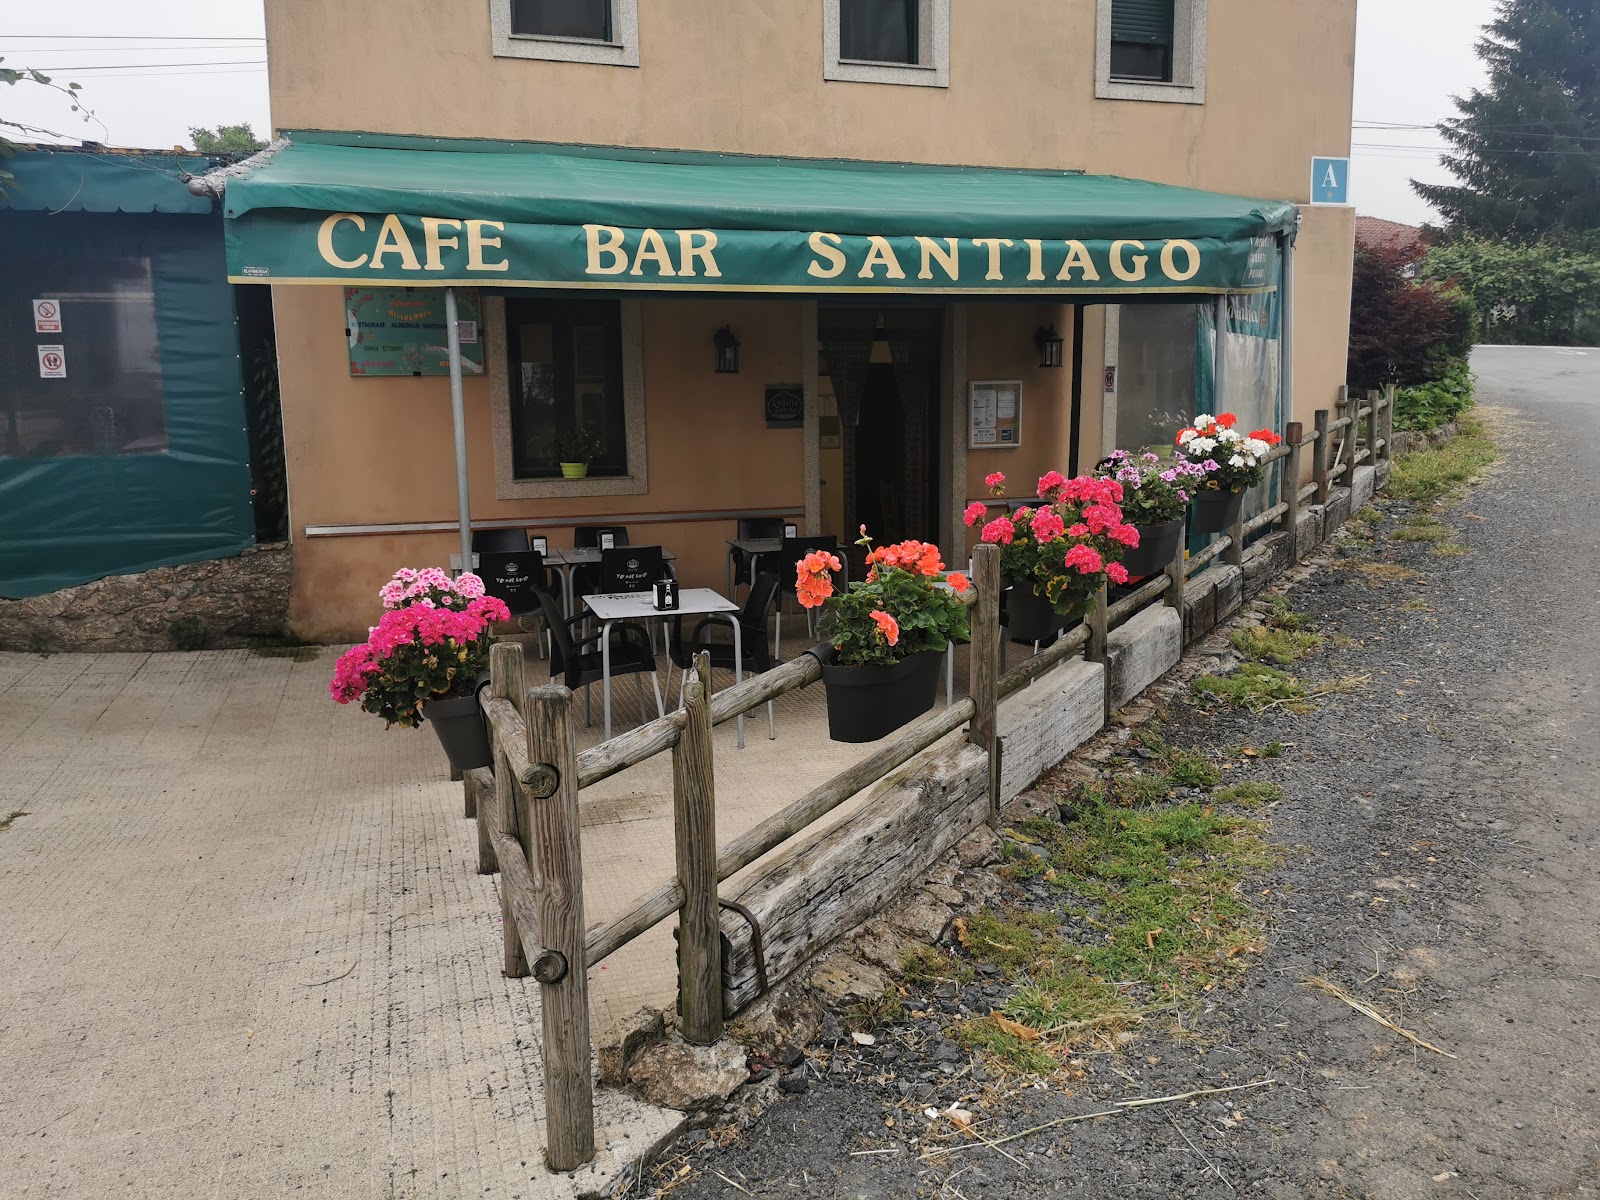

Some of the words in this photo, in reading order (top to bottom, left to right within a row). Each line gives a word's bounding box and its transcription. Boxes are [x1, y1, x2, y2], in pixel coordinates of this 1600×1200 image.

[1321, 162, 1338, 188] A
[316, 213, 509, 273] CAFE
[583, 224, 723, 278] BAR
[807, 231, 1202, 283] SANTIAGO
[388, 310, 432, 321] WILLKOMMEN
